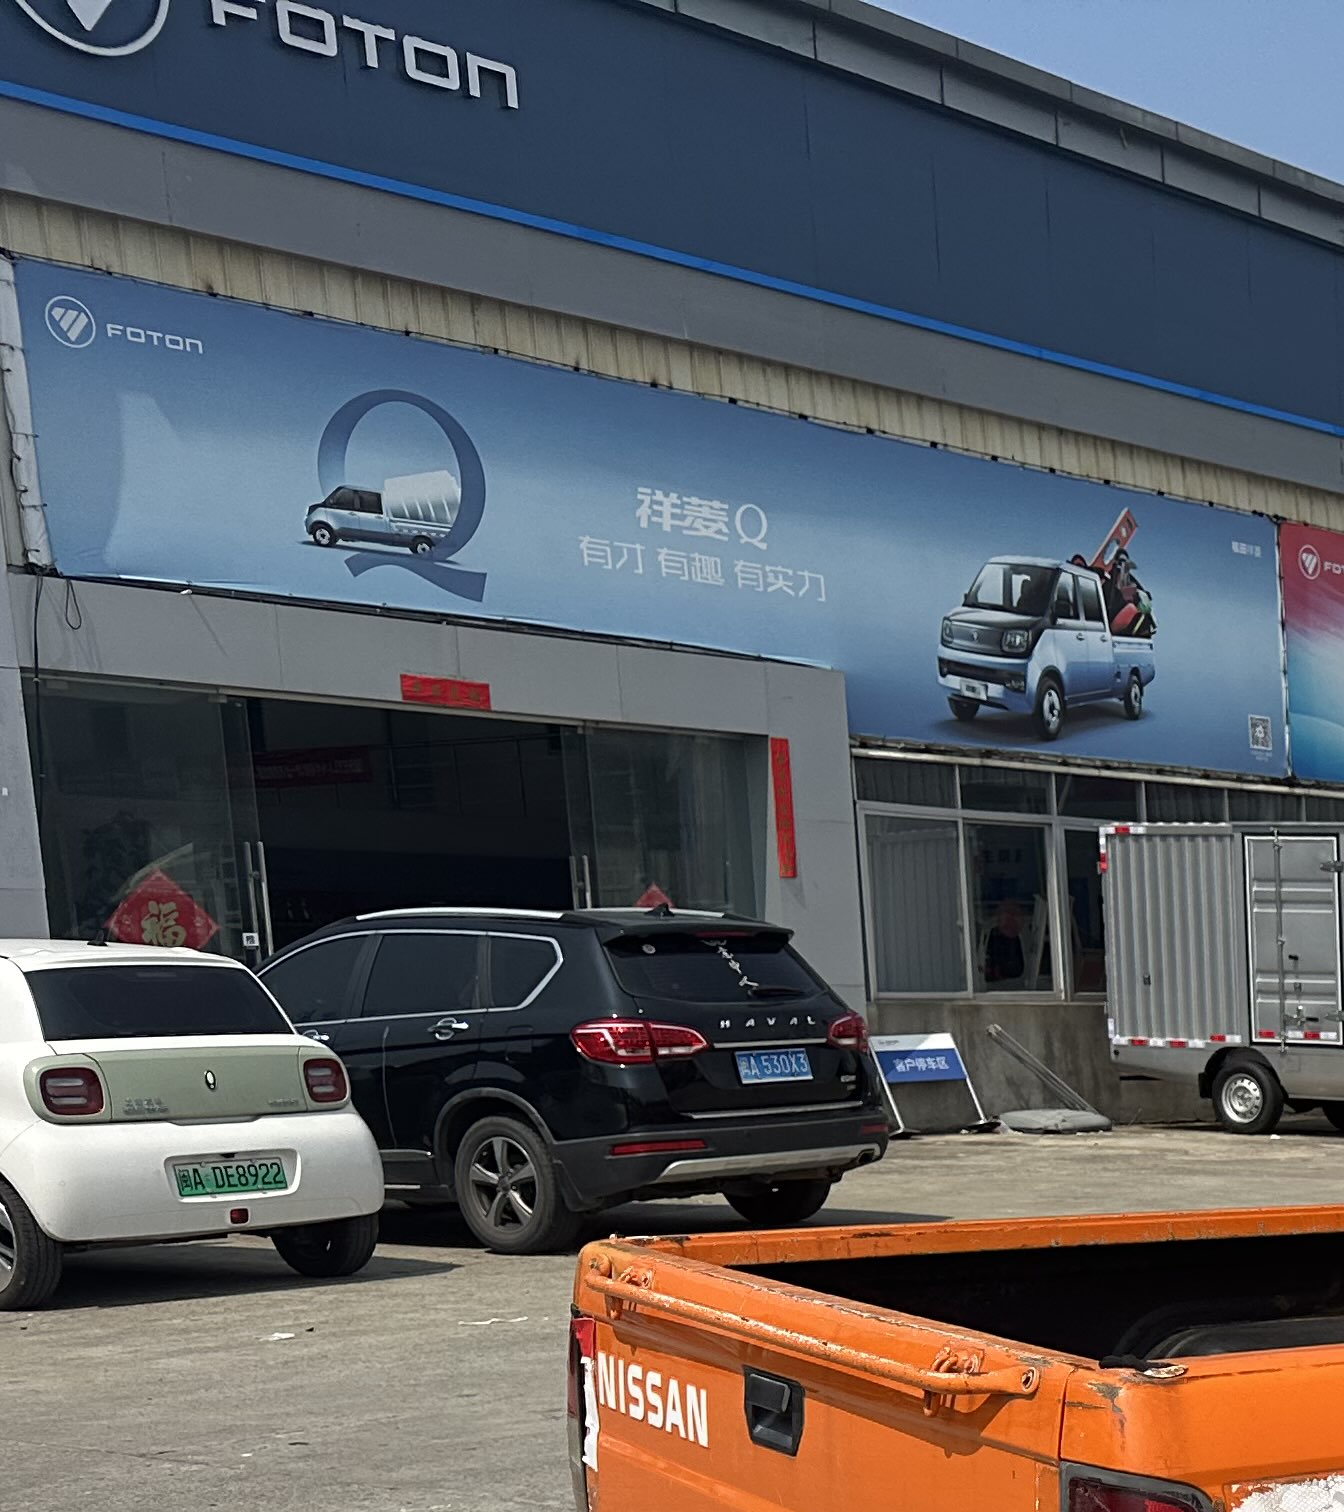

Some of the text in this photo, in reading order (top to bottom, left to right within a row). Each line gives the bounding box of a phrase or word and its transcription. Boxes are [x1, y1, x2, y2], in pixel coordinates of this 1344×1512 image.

[106, 323, 204, 355] FOTON
[720, 1016, 816, 1029] HAVAL
[598, 1351, 709, 1448] NISSAN
